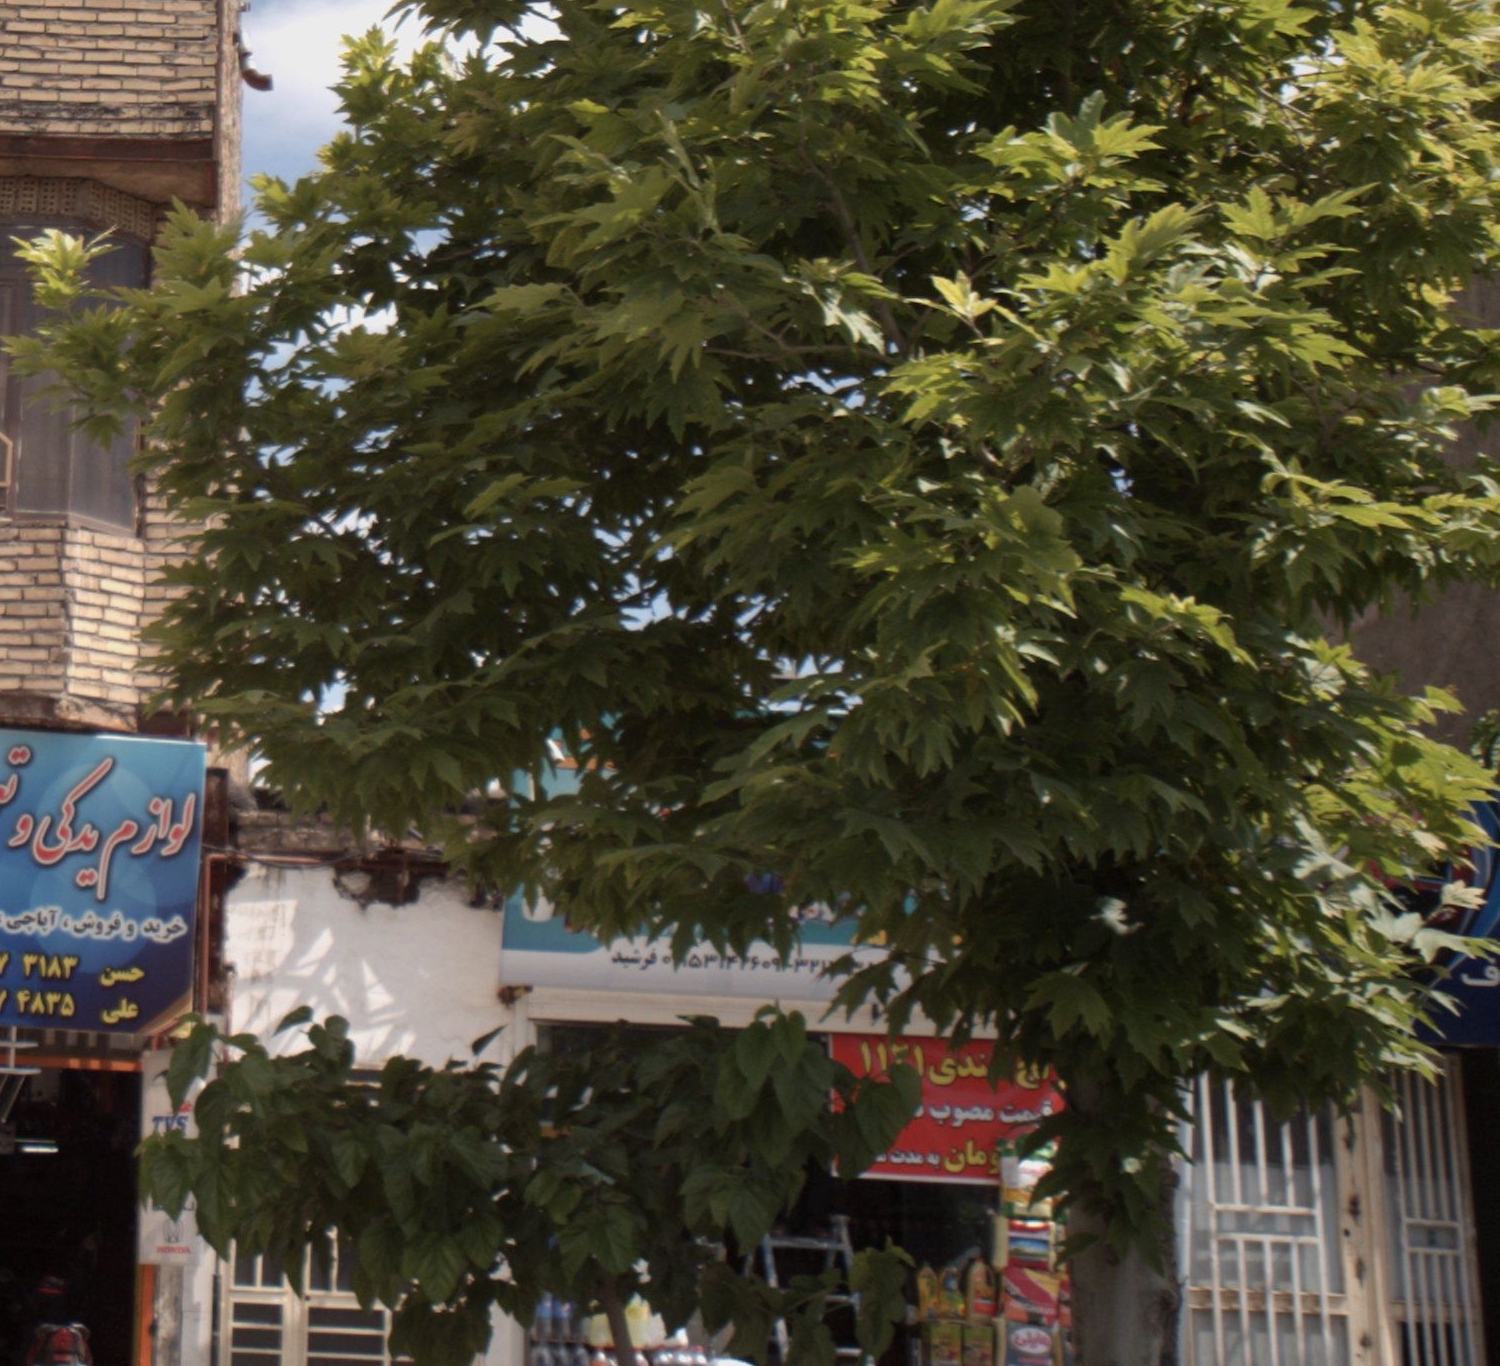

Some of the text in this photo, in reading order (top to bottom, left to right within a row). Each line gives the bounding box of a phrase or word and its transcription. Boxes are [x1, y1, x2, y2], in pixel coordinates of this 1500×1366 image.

[8, 813, 34, 848] و
[32, 757, 114, 887] یدکی
[96, 792, 196, 900] لوازم
[126, 921, 137, 937] و
[143, 917, 186, 940] خرید
[100, 964, 145, 986] حسن
[102, 997, 140, 1025] علی
[943, 1139, 1001, 1175] ومان
